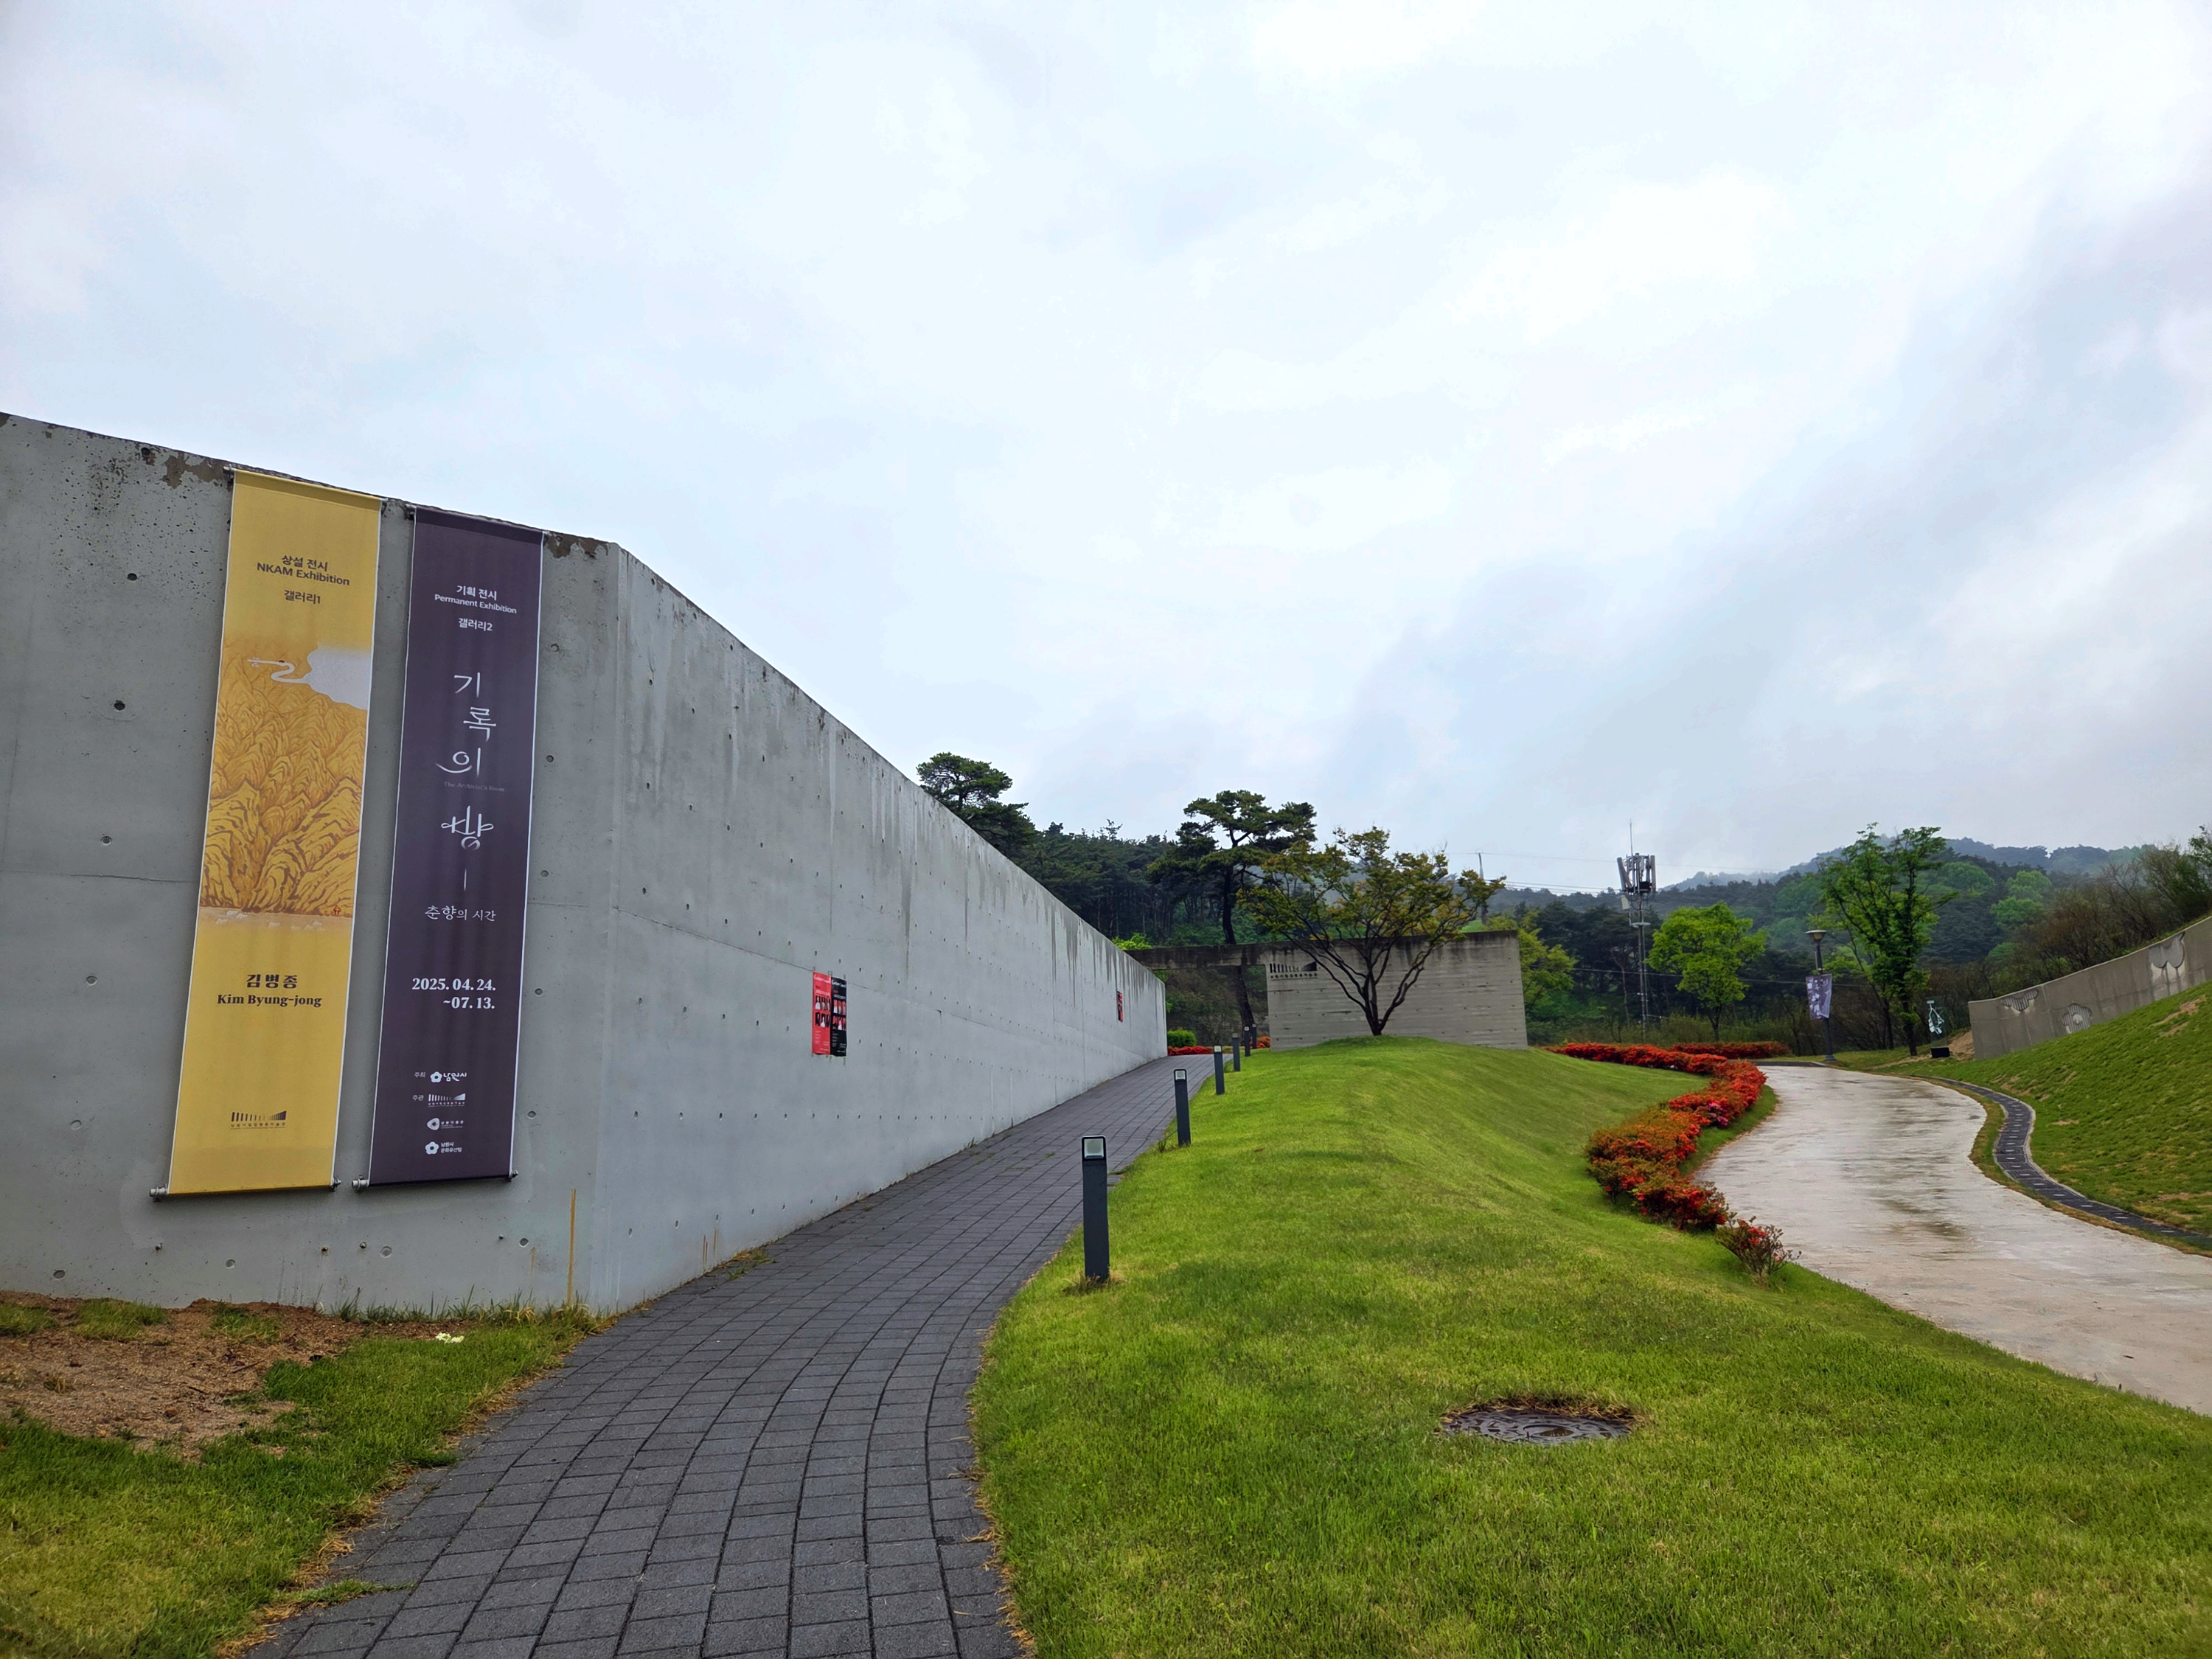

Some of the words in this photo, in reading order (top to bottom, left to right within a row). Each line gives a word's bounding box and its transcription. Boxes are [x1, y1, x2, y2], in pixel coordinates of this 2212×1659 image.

[282, 555, 303, 568] 상설
[307, 559, 328, 572] 전시
[257, 563, 293, 577] NKAM
[296, 569, 350, 586] Exhibition
[284, 589, 321, 605] 갤러리1
[456, 585, 476, 597] 기획
[479, 588, 497, 601] 전시
[434, 594, 478, 608] Permanent
[479, 601, 517, 614] Exhibition
[458, 618, 493, 632] 갤러리2
[425, 905, 467, 921] 춘향의
[472, 909, 497, 922] 시간
[246, 974, 298, 989] 김병종
[411, 978, 450, 990] 2025.
[452, 978, 474, 991] 04.
[476, 978, 496, 991] 24.
[217, 994, 244, 1004] Kim
[247, 995, 322, 1008] Byung-jong
[476, 997, 495, 1009] 13.
